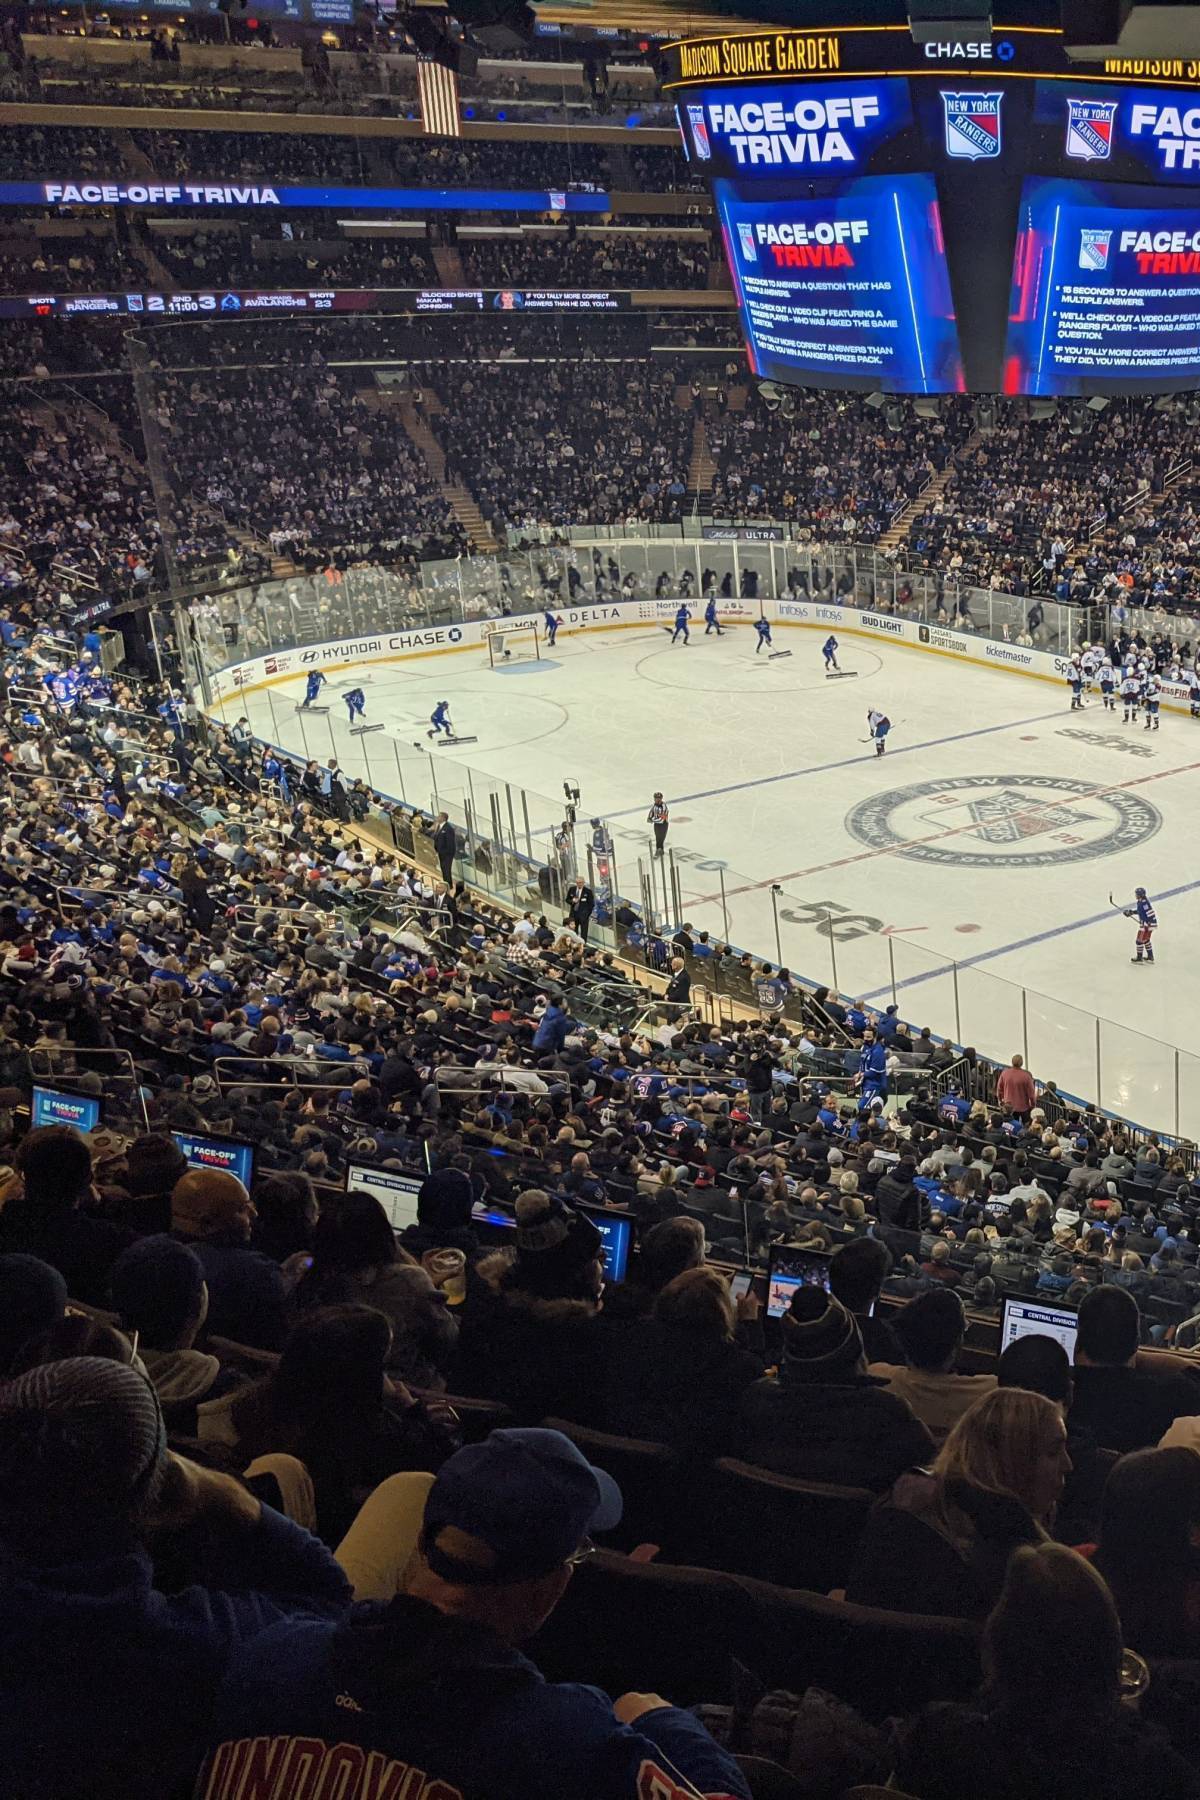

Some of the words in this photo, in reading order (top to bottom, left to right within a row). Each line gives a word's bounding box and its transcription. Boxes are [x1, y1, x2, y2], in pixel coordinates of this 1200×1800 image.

[925, 42, 992, 58] CHASE
[681, 45, 720, 77] MADISON
[722, 40, 771, 73] SQUARE
[776, 36, 840, 71] GARDEN
[948, 101, 969, 112] NEW
[971, 101, 996, 112] YORK
[709, 96, 879, 133] FACE-OFF
[1072, 108, 1089, 117] NEW
[1091, 109, 1110, 120] YORK
[954, 115, 996, 151] RANGERS
[1076, 120, 1108, 154] RANGERS
[730, 132, 855, 163] TRIVIA
[45, 184, 181, 203] FACE-OFF
[185, 187, 280, 205] TRIVIA
[756, 220, 868, 245] FACE-OFF
[771, 245, 854, 267] TRIVIA
[1063, 286, 1071, 294] 15
[1073, 287, 1115, 296] SECONDS
[1128, 288, 1162, 297] ANSWER
[66, 302, 118, 311] RANGERS
[148, 297, 164, 310] 2
[168, 302, 198, 311] 11:00
[199, 297, 216, 310] 3
[244, 299, 307, 307] AVALANCHE
[315, 300, 332, 308] 23
[1061, 296, 1102, 305] MULTIPLE
[1103, 298, 1144, 306] ANSWERS.
[37, 306, 49, 315] 17
[1060, 312, 1085, 321] WE'LL
[1087, 313, 1115, 322] CHECK
[1141, 315, 1163, 323] VIDEO
[1164, 314, 1179, 322] CLIP
[1059, 321, 1100, 331] RANGERS
[1101, 323, 1131, 331] PLAYER
[1139, 323, 1157, 332] WHO
[1158, 323, 1173, 331] WAS
[1058, 331, 1103, 340] QUESTION.
[1055, 346, 1063, 354] IF
[1064, 347, 1082, 355] YOU
[1084, 347, 1108, 356] TALLY
[1108, 348, 1131, 357] MORE
[1133, 348, 1167, 357] CORRECT
[1054, 355, 1077, 364] THEY
[1077, 356, 1094, 365] DID,
[1096, 357, 1112, 365] YOU
[1136, 357, 1170, 366] RANGERS
[745, 532, 776, 540] ULTRA
[570, 608, 621, 622] DELTA
[779, 604, 808, 616] Infosys
[816, 608, 842, 620] Infosys
[862, 616, 878, 628] BUD
[879, 619, 902, 632] LIGHT
[931, 628, 952, 638] CAESARS
[389, 632, 444, 650] CHASE
[931, 636, 967, 652] SPORTSBOOK
[323, 641, 381, 659] HYUNDAI
[986, 645, 1032, 664] ticketmaster
[1102, 667, 1109, 678] 29
[931, 777, 1000, 790] NEW
[1014, 777, 1091, 792] YORK
[1105, 794, 1144, 840] RANGERS
[961, 854, 1054, 865] GARDEN
[780, 900, 884, 942] 5G
[52, 1101, 84, 1114] FACE-OFF
[57, 1109, 79, 1118] TRIVIA
[194, 1146, 236, 1159] FACE-OFF
[200, 1155, 230, 1166] TRIVIA
[367, 1177, 386, 1185] CENTRAL
[387, 1181, 405, 1189] DIVISION
[1028, 1312, 1051, 1322] CENTRAL
[1053, 1317, 1076, 1327] DIVISION
